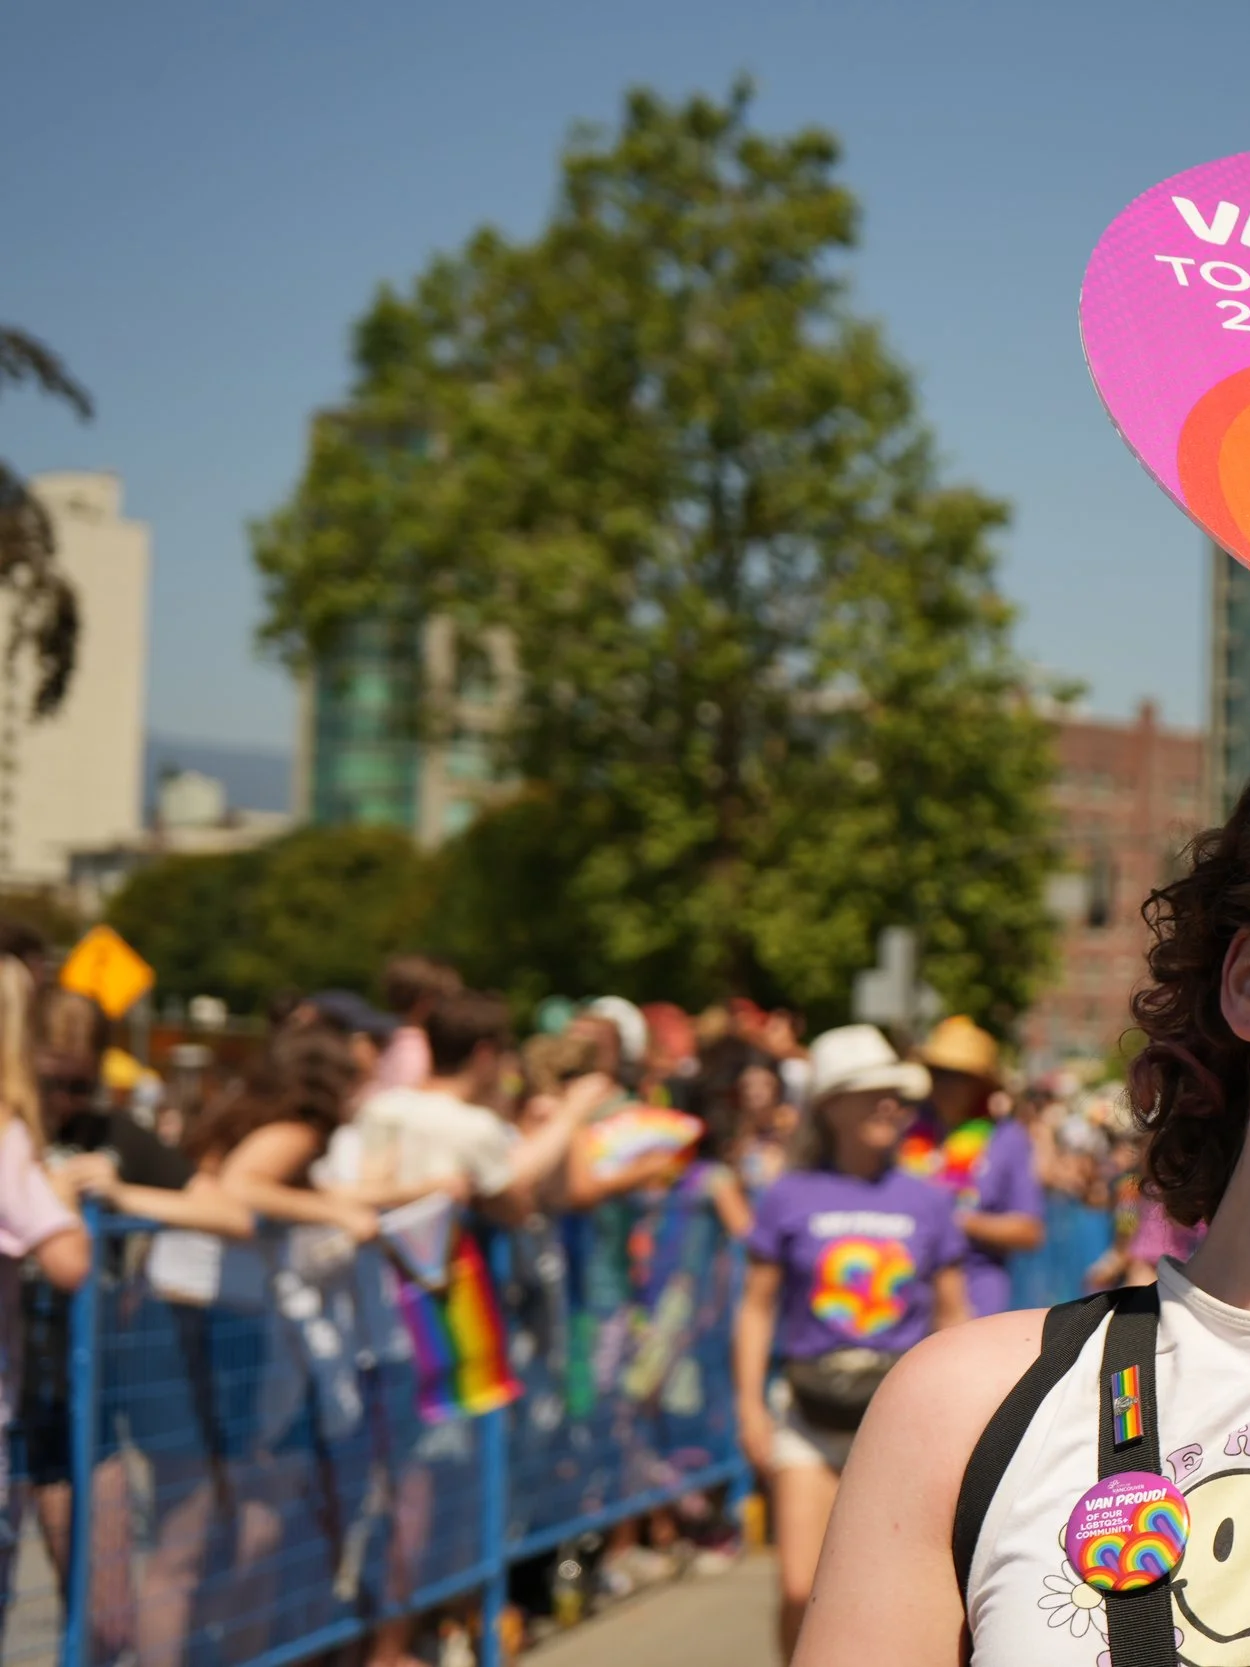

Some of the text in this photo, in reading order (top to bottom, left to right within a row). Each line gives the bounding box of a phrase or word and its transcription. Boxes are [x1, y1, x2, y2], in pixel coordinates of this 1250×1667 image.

[1085, 1488, 1168, 1511] VAN PROUD!
[1086, 1509, 1123, 1521] OF OUR
[1075, 1524, 1134, 1540] COMMUNITY
